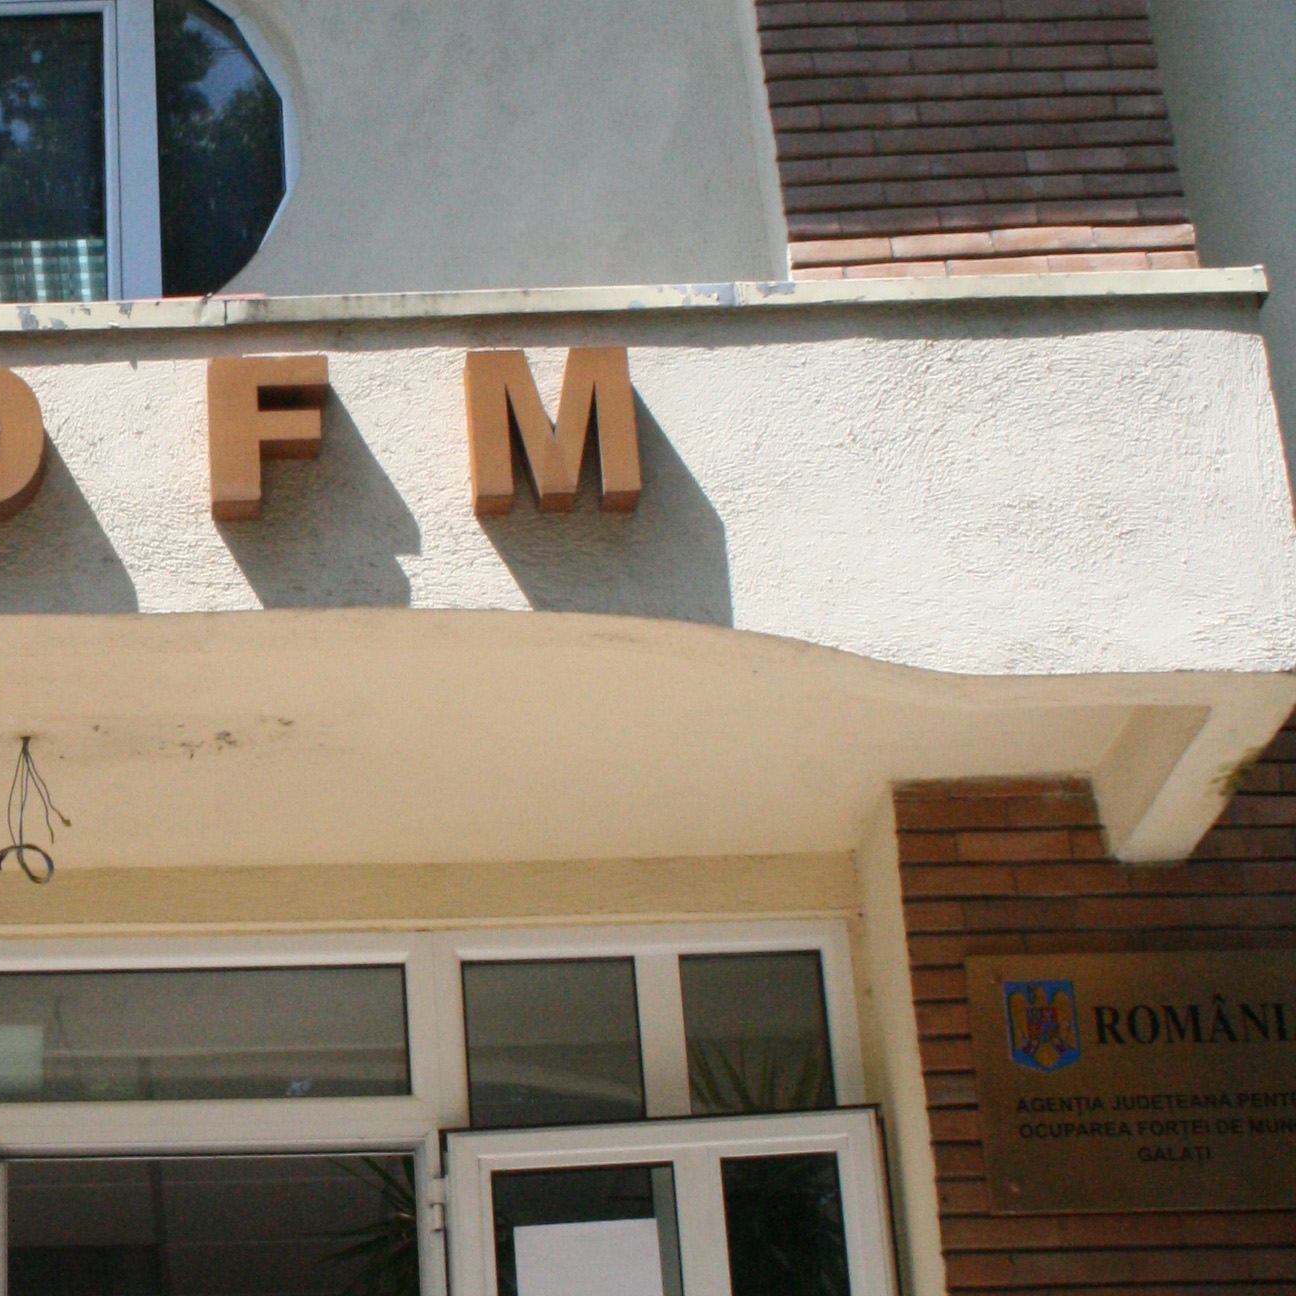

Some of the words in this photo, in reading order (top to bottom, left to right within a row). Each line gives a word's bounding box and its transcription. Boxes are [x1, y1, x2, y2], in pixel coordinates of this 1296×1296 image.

[1093, 993, 1296, 1045] ROMÂNI
[1238, 1091, 1296, 1109] PENT
[1019, 1120, 1132, 1140] OCUPAREA
[1217, 1117, 1243, 1135] DE
[1249, 1116, 1296, 1135] MUN
